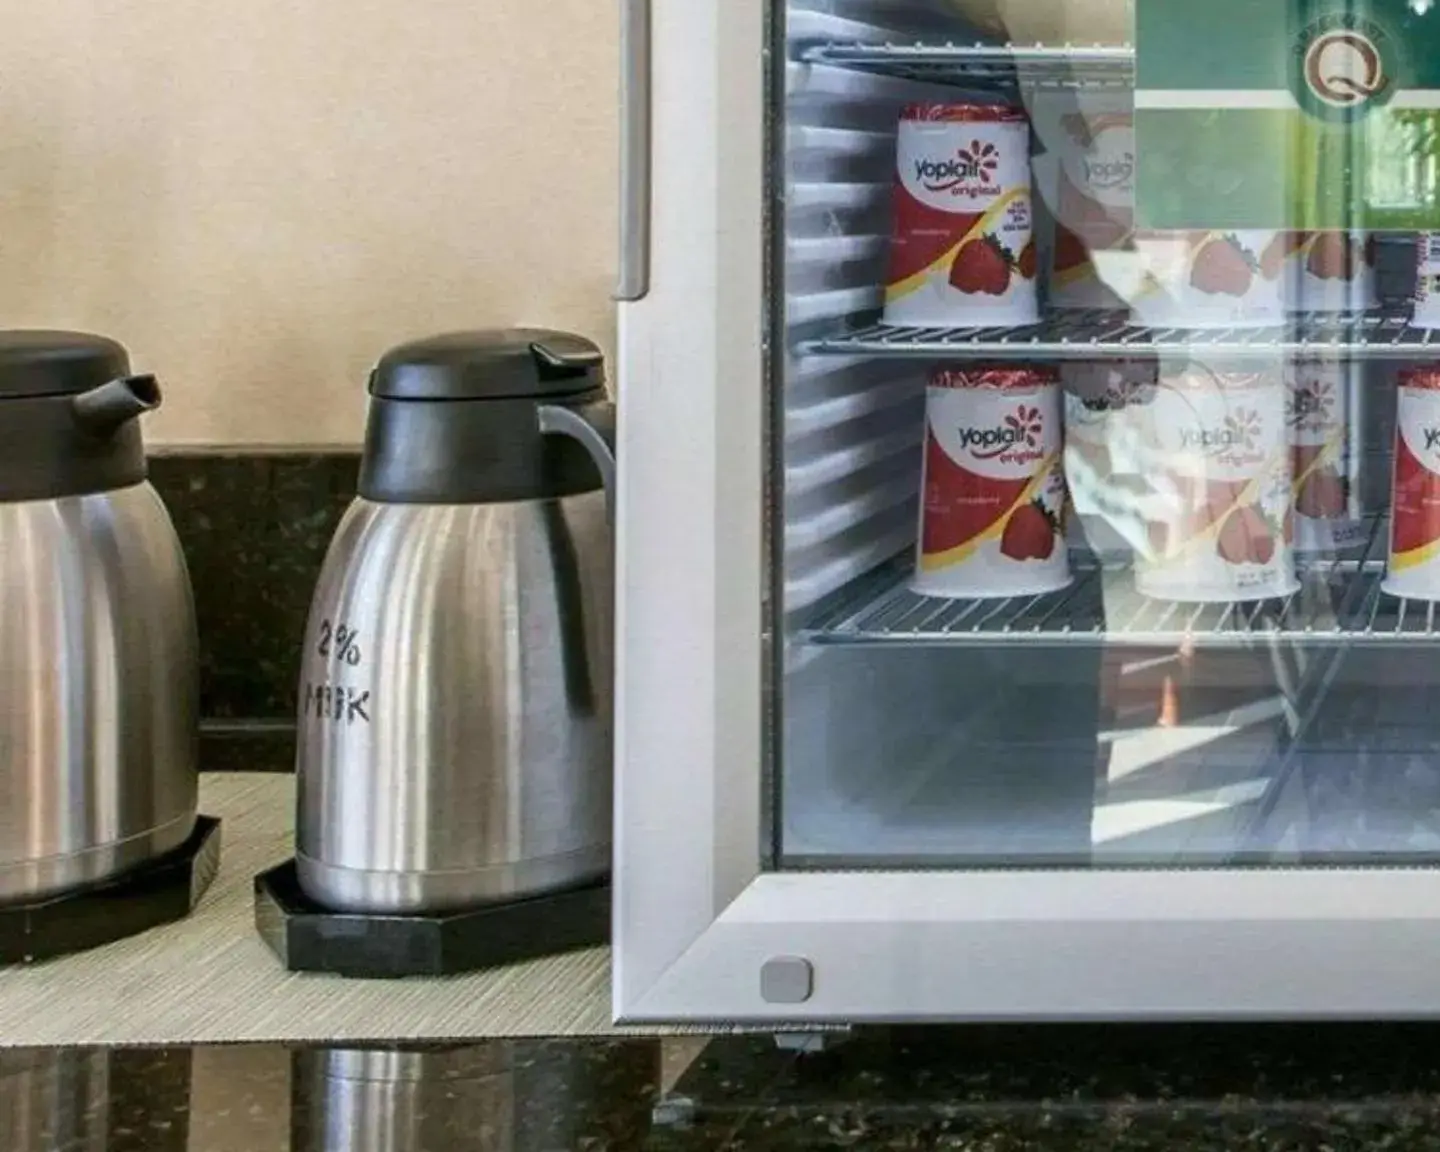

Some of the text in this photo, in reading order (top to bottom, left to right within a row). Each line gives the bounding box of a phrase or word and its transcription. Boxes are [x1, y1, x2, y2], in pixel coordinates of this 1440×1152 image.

[914, 158, 981, 180] Yoplait
[950, 183, 1001, 198] original
[959, 426, 1024, 448] Yoplait
[318, 618, 361, 667] 2%
